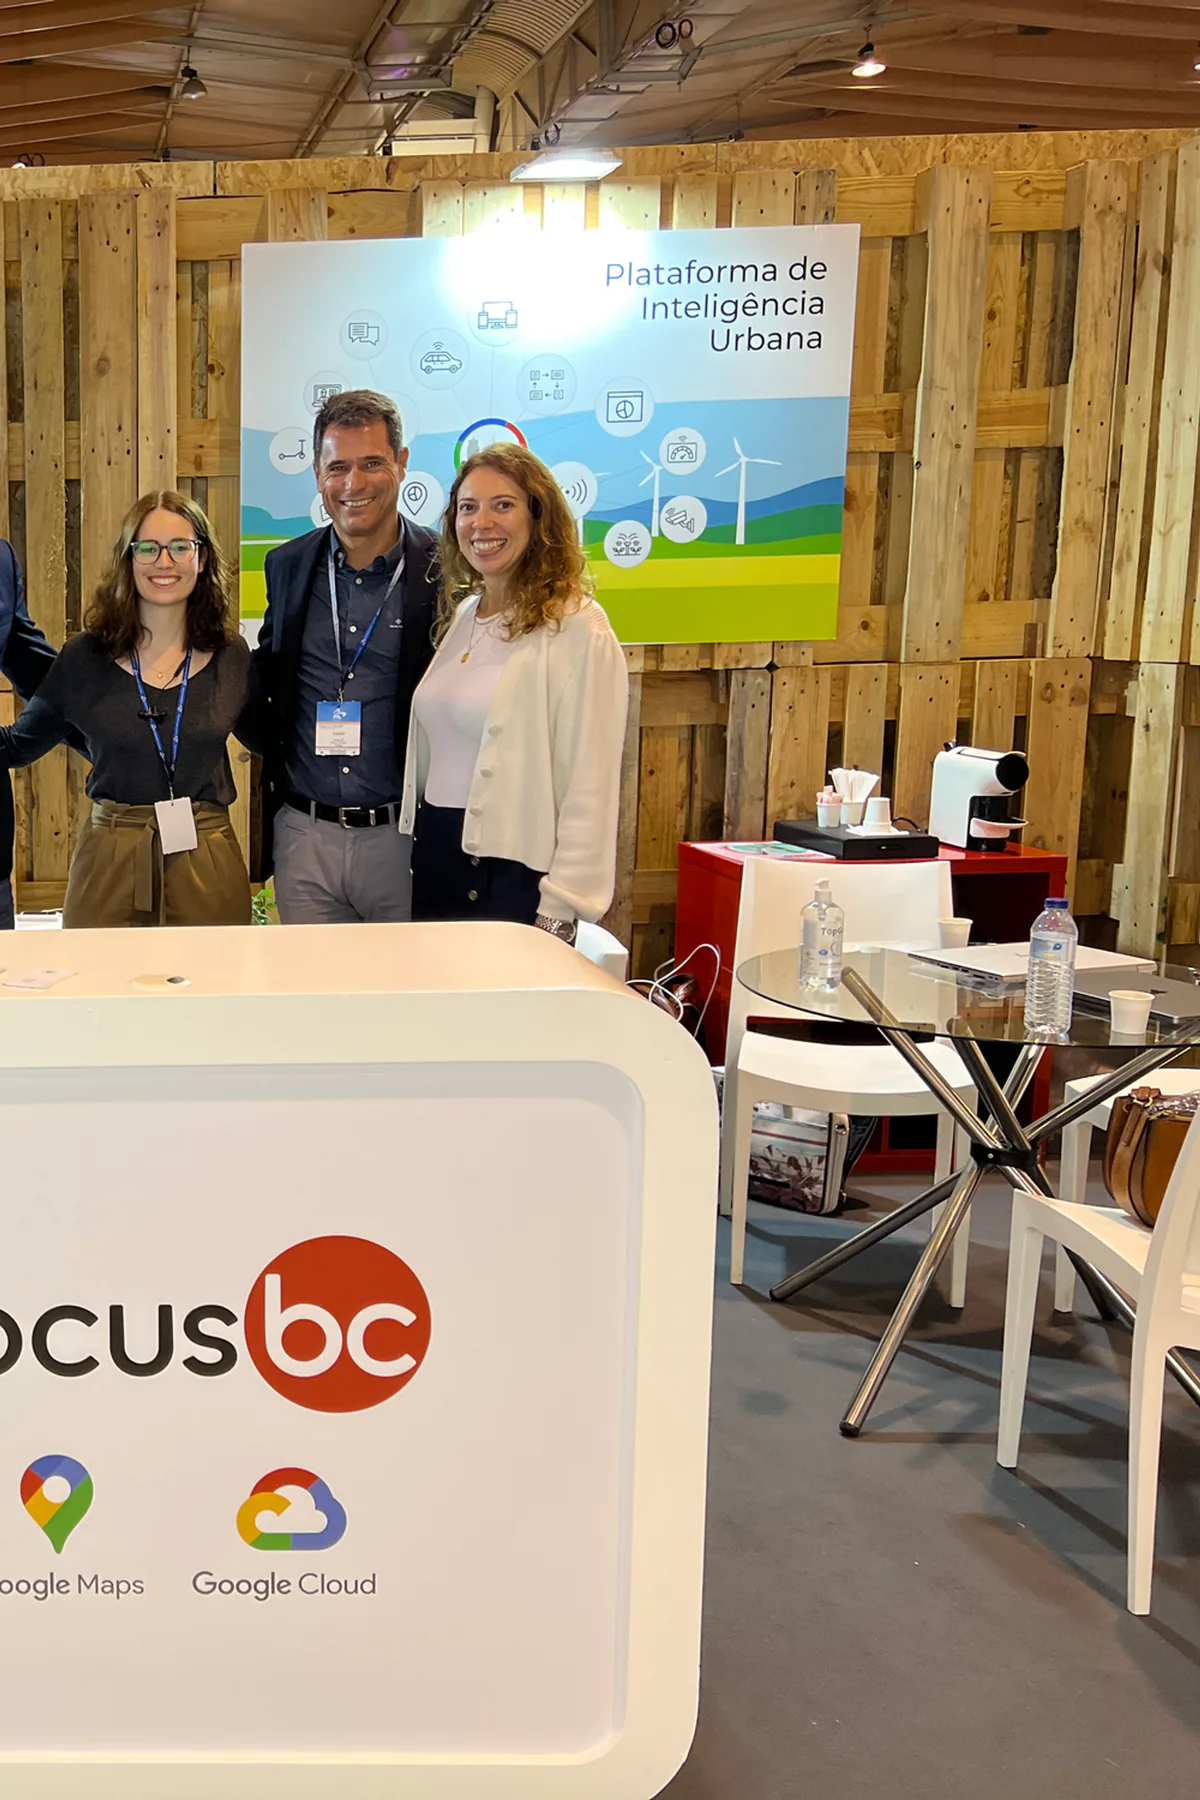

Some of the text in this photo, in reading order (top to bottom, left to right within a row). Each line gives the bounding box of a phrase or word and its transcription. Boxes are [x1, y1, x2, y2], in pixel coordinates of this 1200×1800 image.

[605, 255, 828, 287] Plataforma de
[642, 290, 824, 324] Inteligência
[710, 327, 823, 352] Urbana
[77, 1573, 145, 1600] Maps
[191, 1570, 377, 1602] Google Cloud
